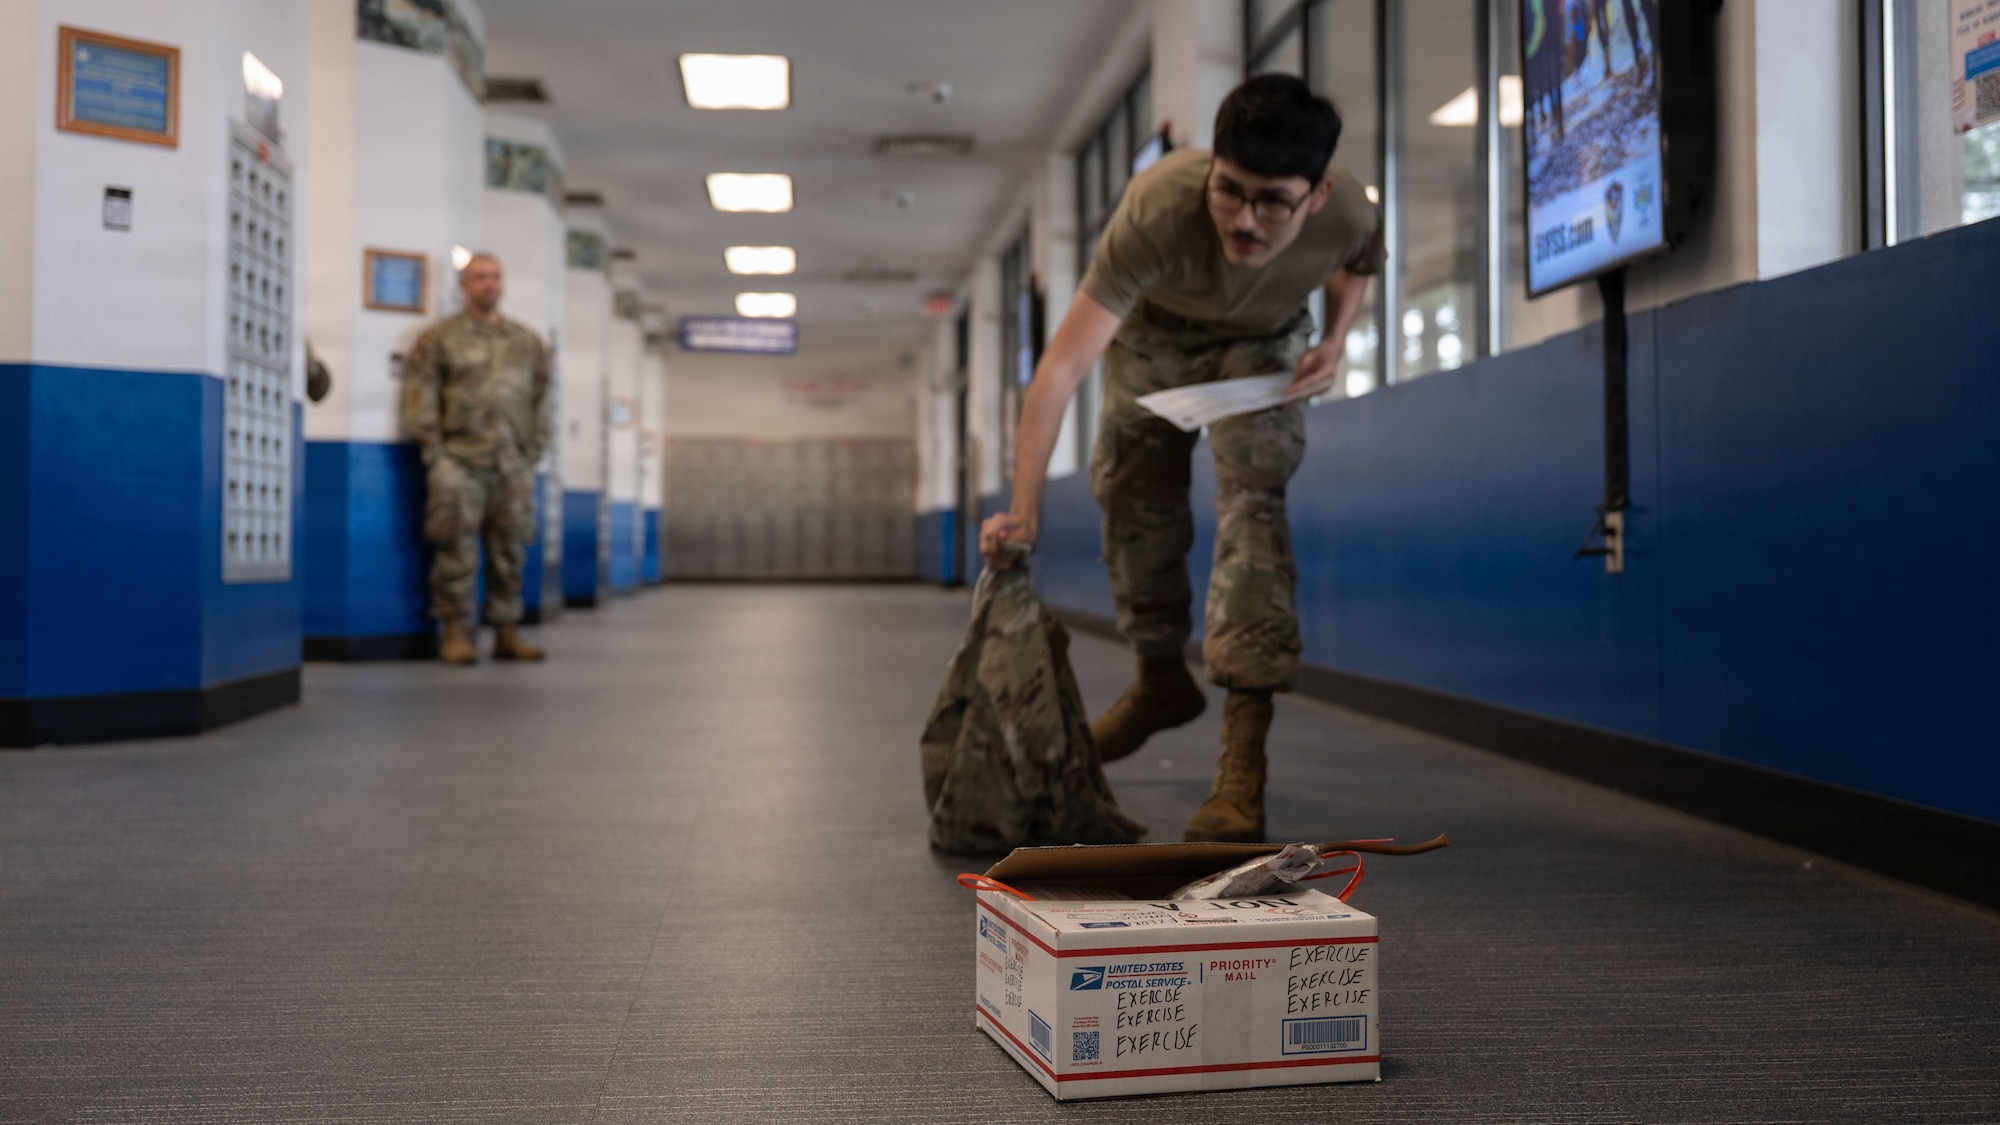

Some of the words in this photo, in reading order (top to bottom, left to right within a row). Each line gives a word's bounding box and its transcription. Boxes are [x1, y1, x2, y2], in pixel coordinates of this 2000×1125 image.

[1204, 898, 1299, 911] NOT
[1108, 963, 1149, 974] UNITED
[1148, 961, 1184, 972] STATES
[1289, 945, 1370, 971] EXERCISE
[1105, 979, 1143, 990] POSTAL
[1225, 972, 1257, 982] MAIL
[1287, 967, 1365, 995] EXERCISE
[1116, 984, 1184, 1010] EXERCISE
[1287, 989, 1371, 1015] EXERCISE
[1116, 1004, 1186, 1030] EXERCISE
[1116, 1023, 1198, 1058] EXERCISE
[1301, 1042, 1347, 1051] PS00011132700
